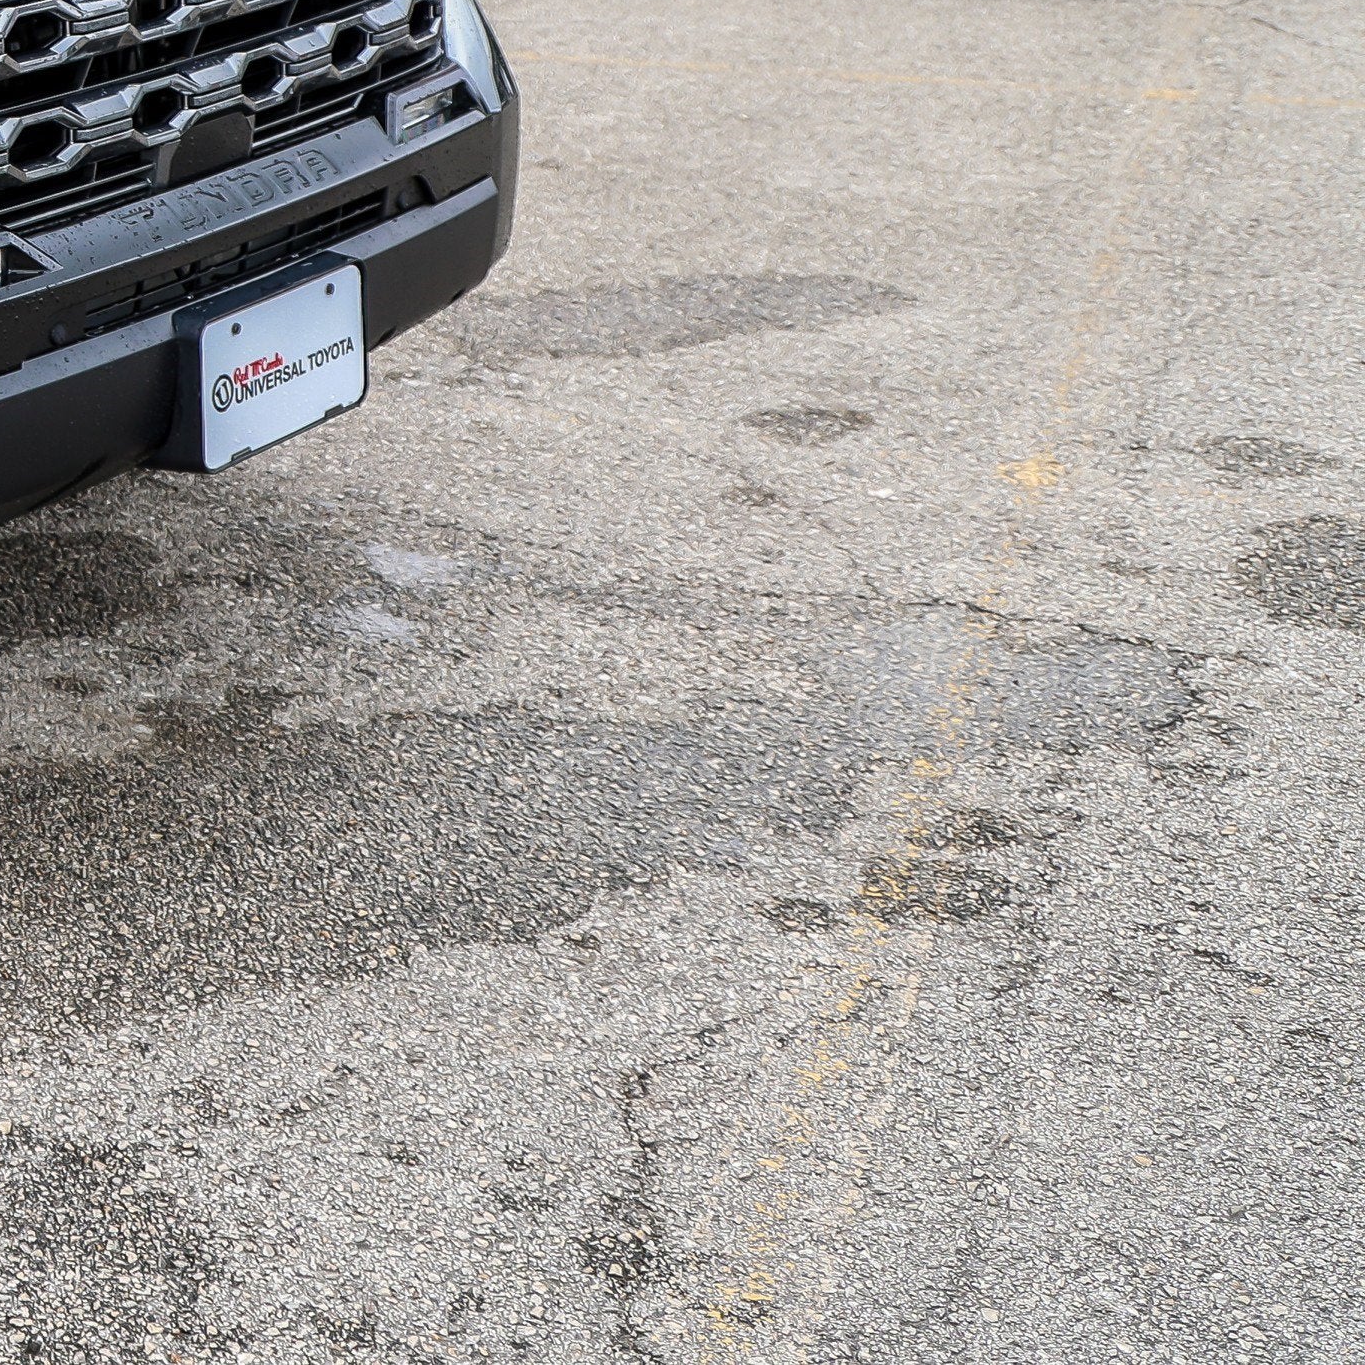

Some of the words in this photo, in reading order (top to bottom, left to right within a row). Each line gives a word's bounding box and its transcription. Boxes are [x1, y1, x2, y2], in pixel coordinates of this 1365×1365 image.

[111, 148, 342, 244] TUNDRA
[235, 359, 306, 404] UNIVERSAL
[307, 336, 355, 374] TOYOTA
